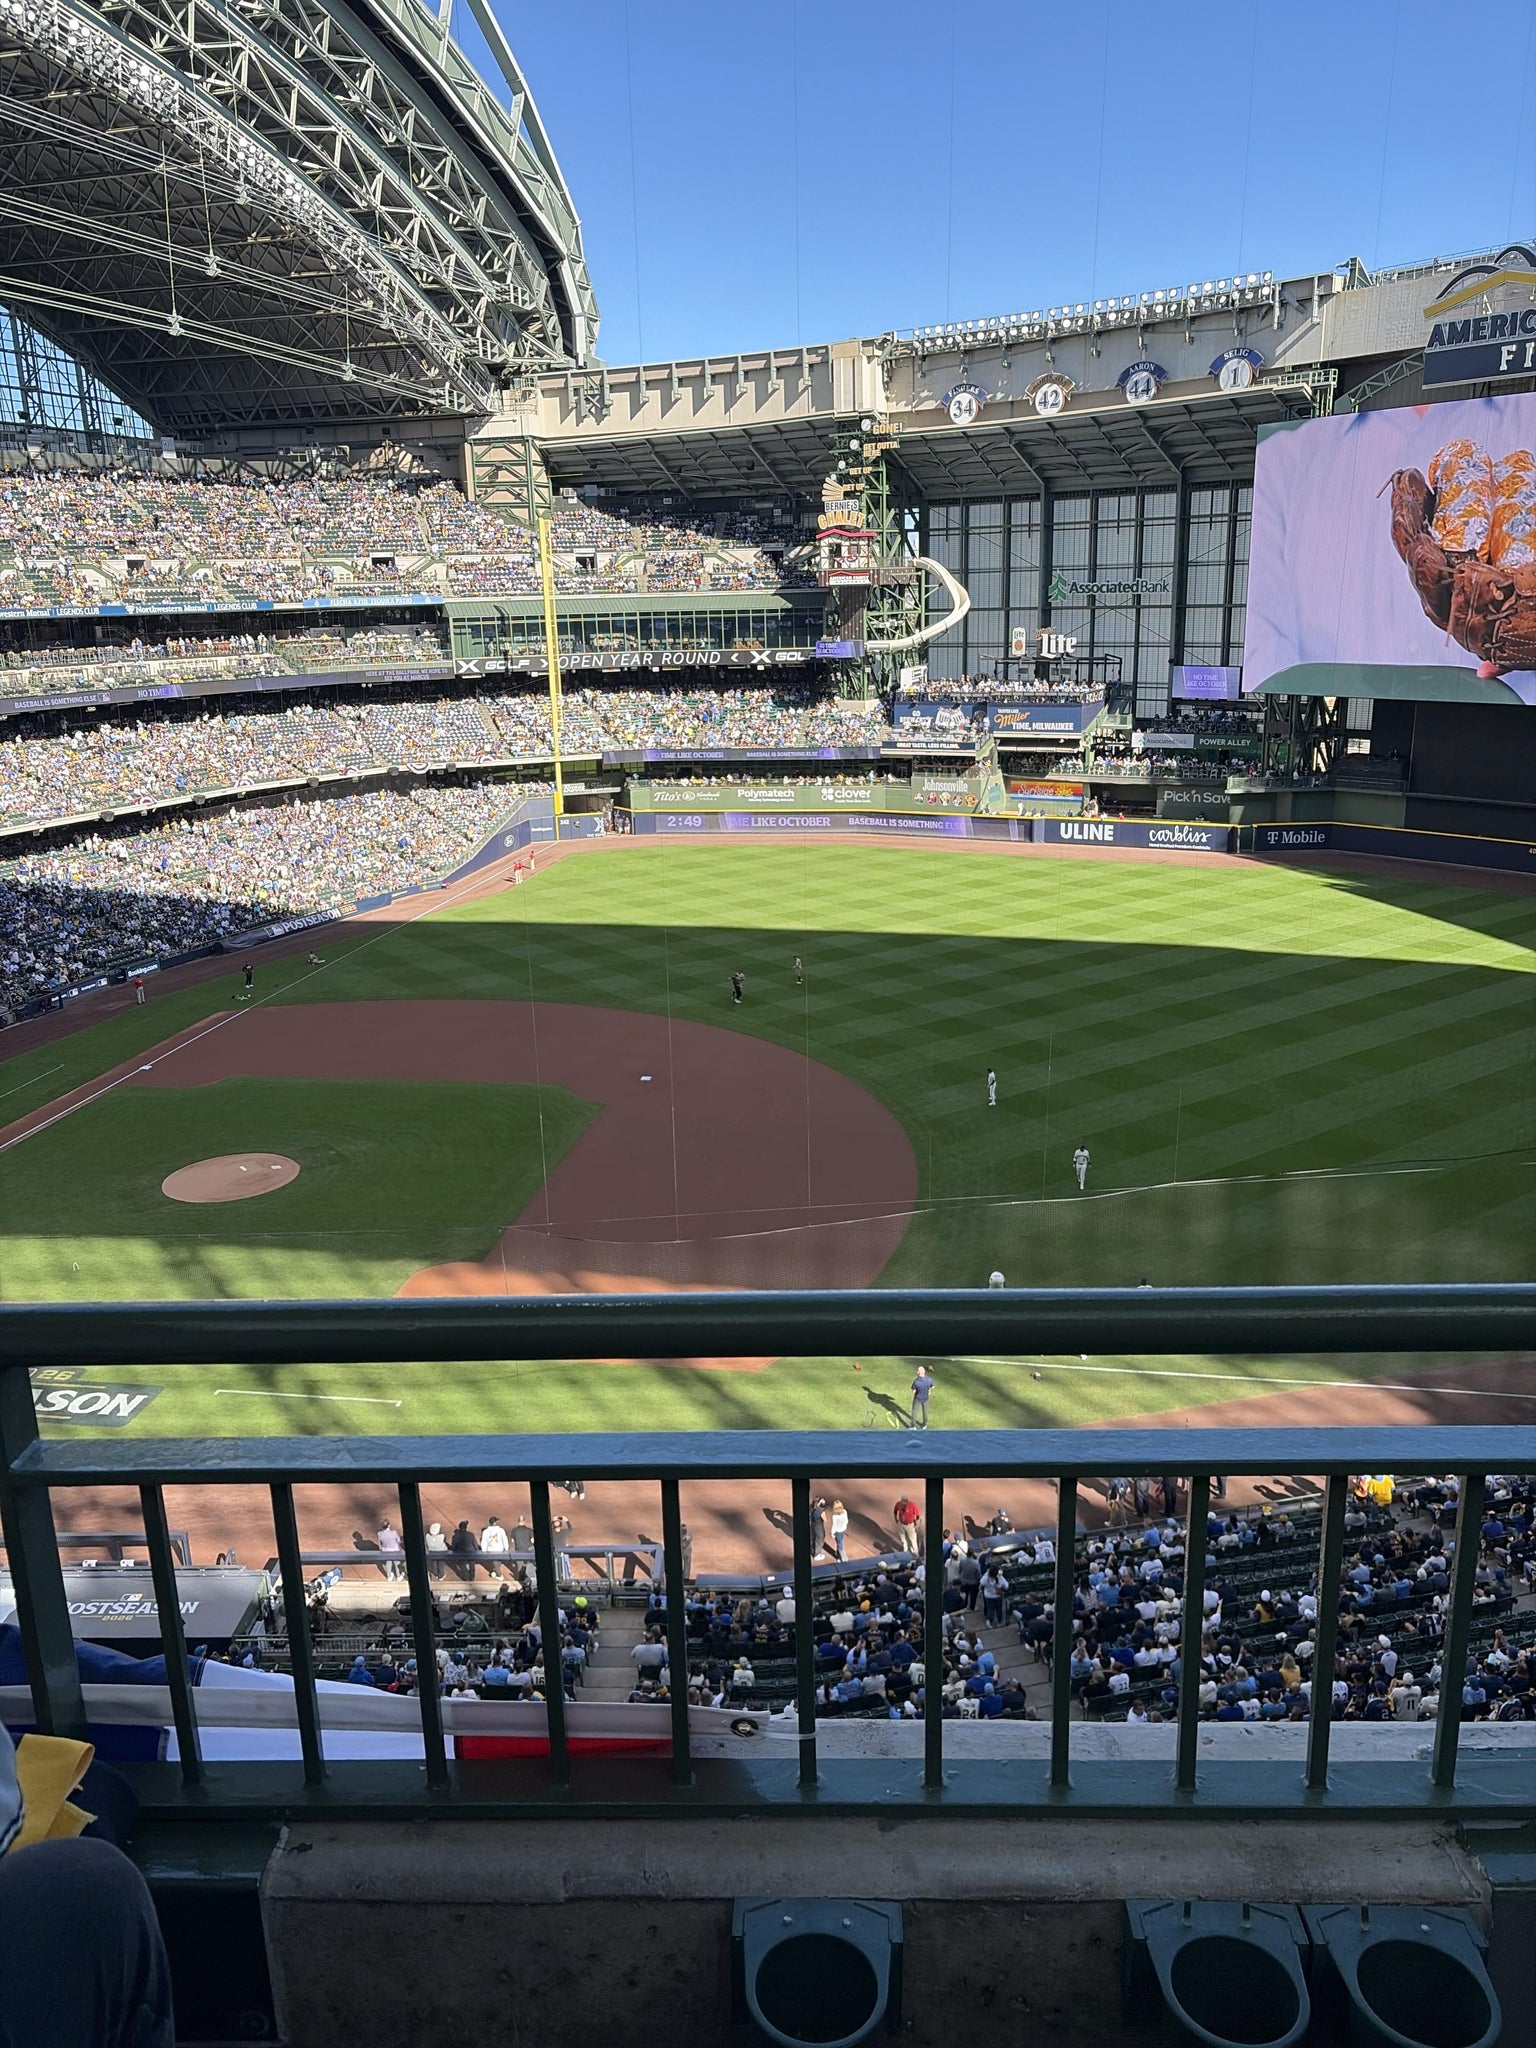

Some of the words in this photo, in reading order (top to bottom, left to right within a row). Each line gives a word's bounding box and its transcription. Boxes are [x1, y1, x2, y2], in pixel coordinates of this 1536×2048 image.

[1427, 309, 1536, 348] AMERIC
[1223, 349, 1249, 360] SELIG
[1499, 342, 1535, 371] FI
[1129, 363, 1155, 374] AARON
[1230, 367, 1240, 388] 1
[948, 386, 980, 398] FINGERS
[1129, 378, 1151, 398] 44
[1039, 390, 1060, 409] 42
[953, 400, 973, 418] 34
[825, 501, 858, 511] BERNIE'S
[817, 511, 866, 529] CHALET
[56, 608, 83, 616] LEGENDS
[136, 604, 183, 614] Northwestern
[184, 603, 207, 612] Mutual
[214, 603, 241, 611] LEGENDS
[242, 602, 257, 610] CLUB
[1040, 633, 1077, 659] Lite
[457, 660, 480, 673] X
[485, 660, 530, 671] GOLF
[558, 655, 603, 668] OPEN
[610, 652, 653, 667] YEAR
[662, 652, 721, 664] ROUND
[148, 688, 167, 697] TIME
[15, 701, 44, 709] BASEBALL
[51, 697, 83, 706] SOMETHING
[994, 712, 1030, 728] Miller
[1012, 722, 1031, 731] TIME,
[1032, 722, 1074, 731] MILWAUKEE
[1199, 738, 1225, 746] POWER
[922, 779, 968, 792] Johnsonville
[1017, 784, 1054, 796] Surfside
[654, 791, 681, 802] Tito's
[737, 789, 794, 798] Polymatech
[834, 788, 871, 798] clover
[667, 816, 702, 827] 2:49
[751, 818, 777, 827] LIKE
[778, 817, 831, 827] OCTOBER
[848, 818, 888, 826] BASEBALL
[898, 819, 944, 829] SOMETHING
[1060, 823, 1114, 841] ULINE
[1149, 825, 1212, 843] carbliss
[1281, 831, 1325, 844] Mobile
[283, 908, 341, 933] POSTSEASON
[128, 964, 158, 977] Booking.com
[37, 1370, 75, 1381] 26
[535, 1676, 545, 1686] 16
[963, 1709, 976, 1719] 24
